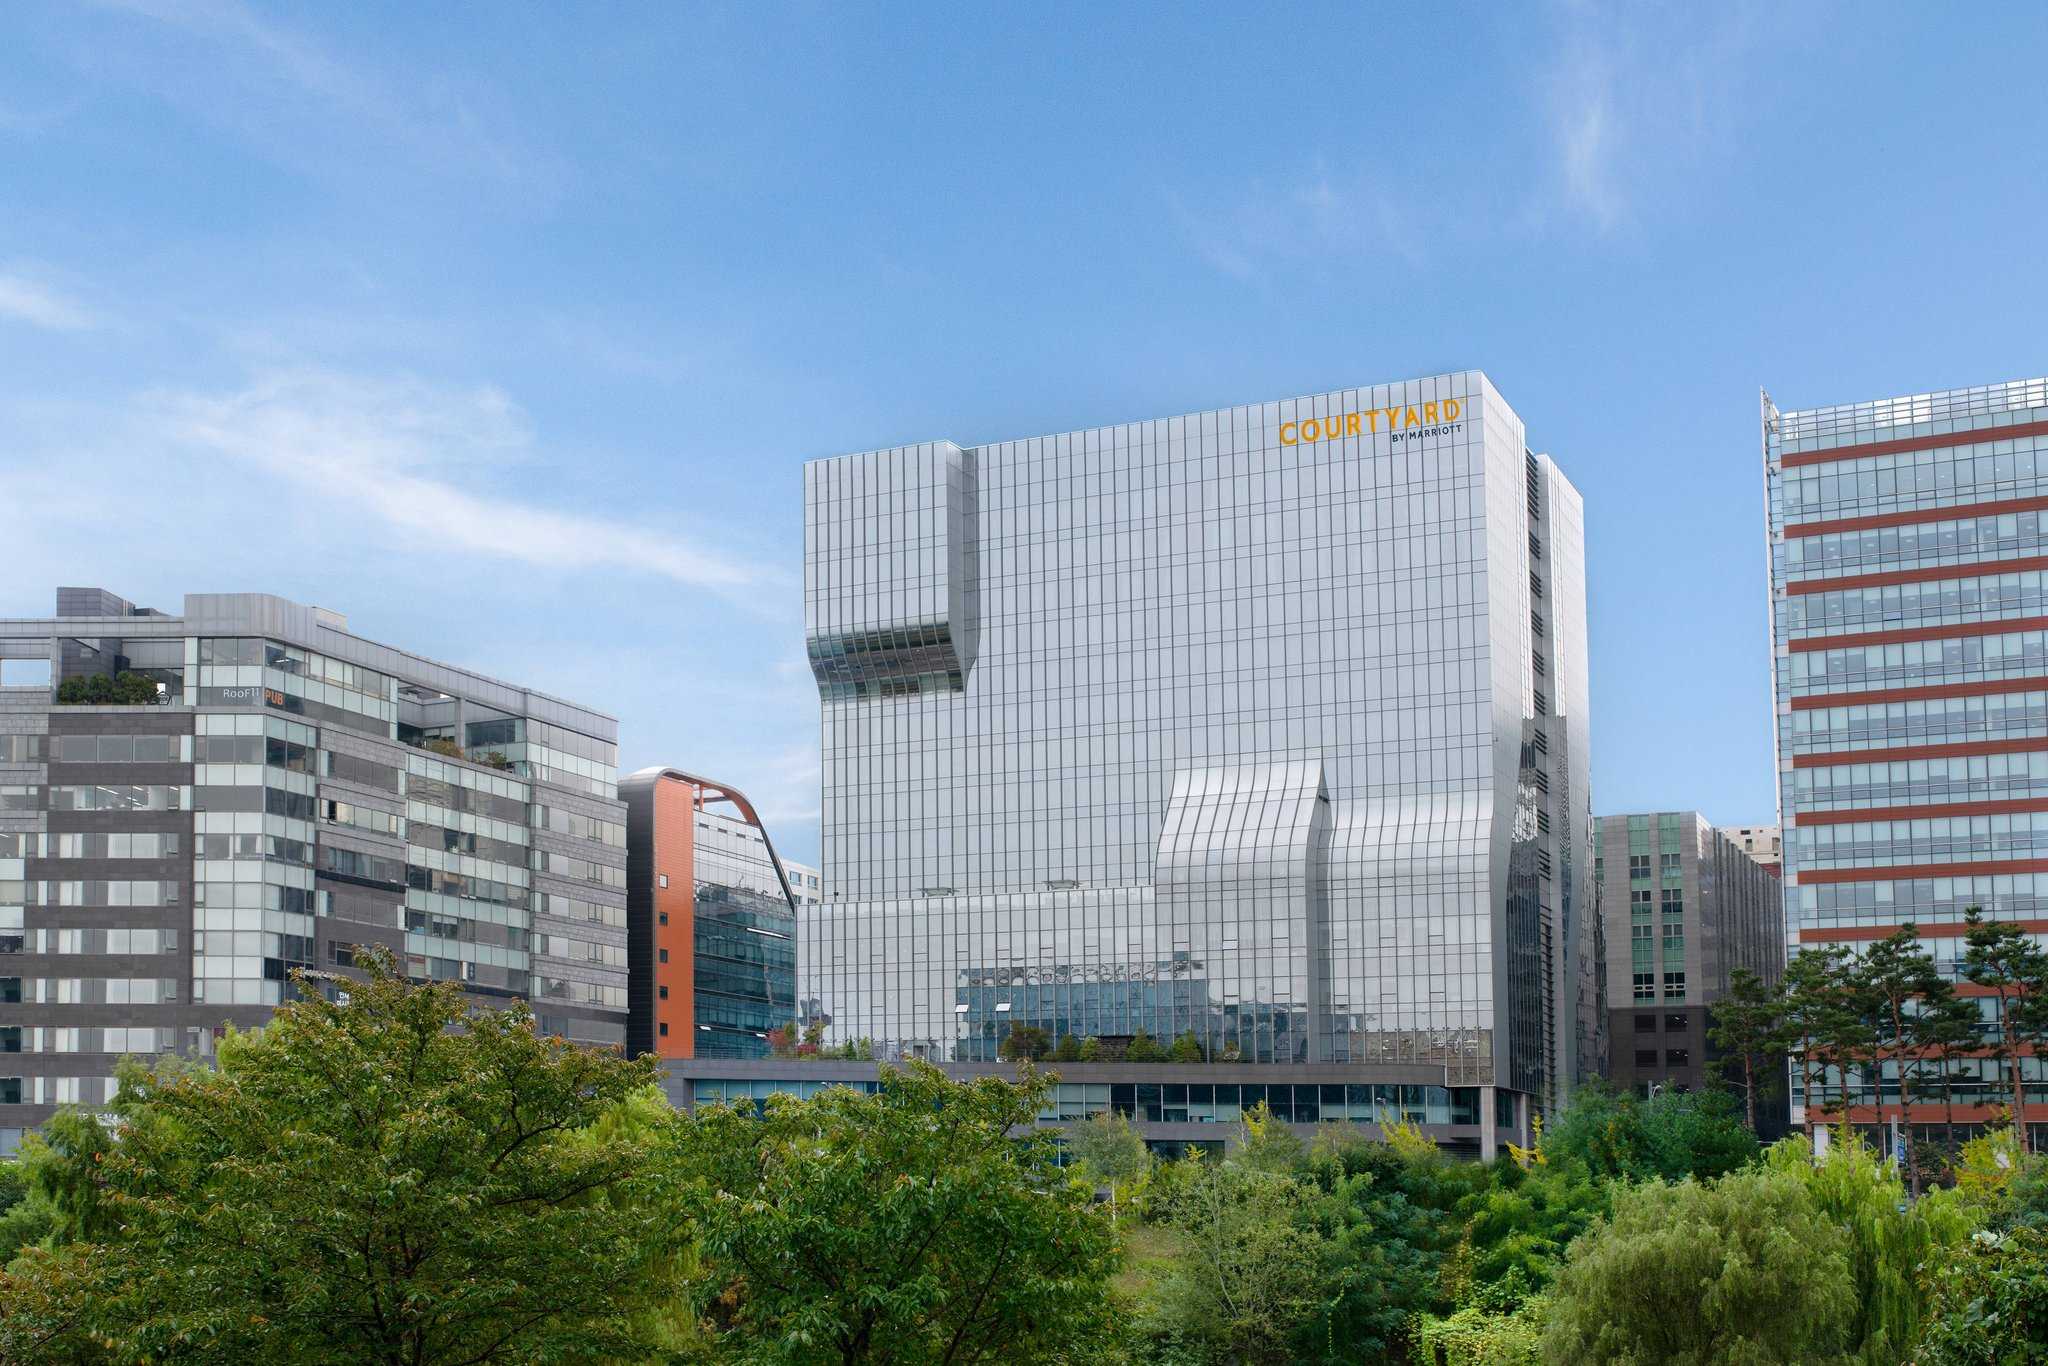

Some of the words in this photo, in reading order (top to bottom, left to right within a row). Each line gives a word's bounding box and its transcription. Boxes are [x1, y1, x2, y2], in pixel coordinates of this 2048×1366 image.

[1280, 399, 1460, 444] COURTYARD
[1392, 433, 1404, 442] BY
[1409, 424, 1461, 440] MARRIOTT
[264, 689, 284, 705] PUB
